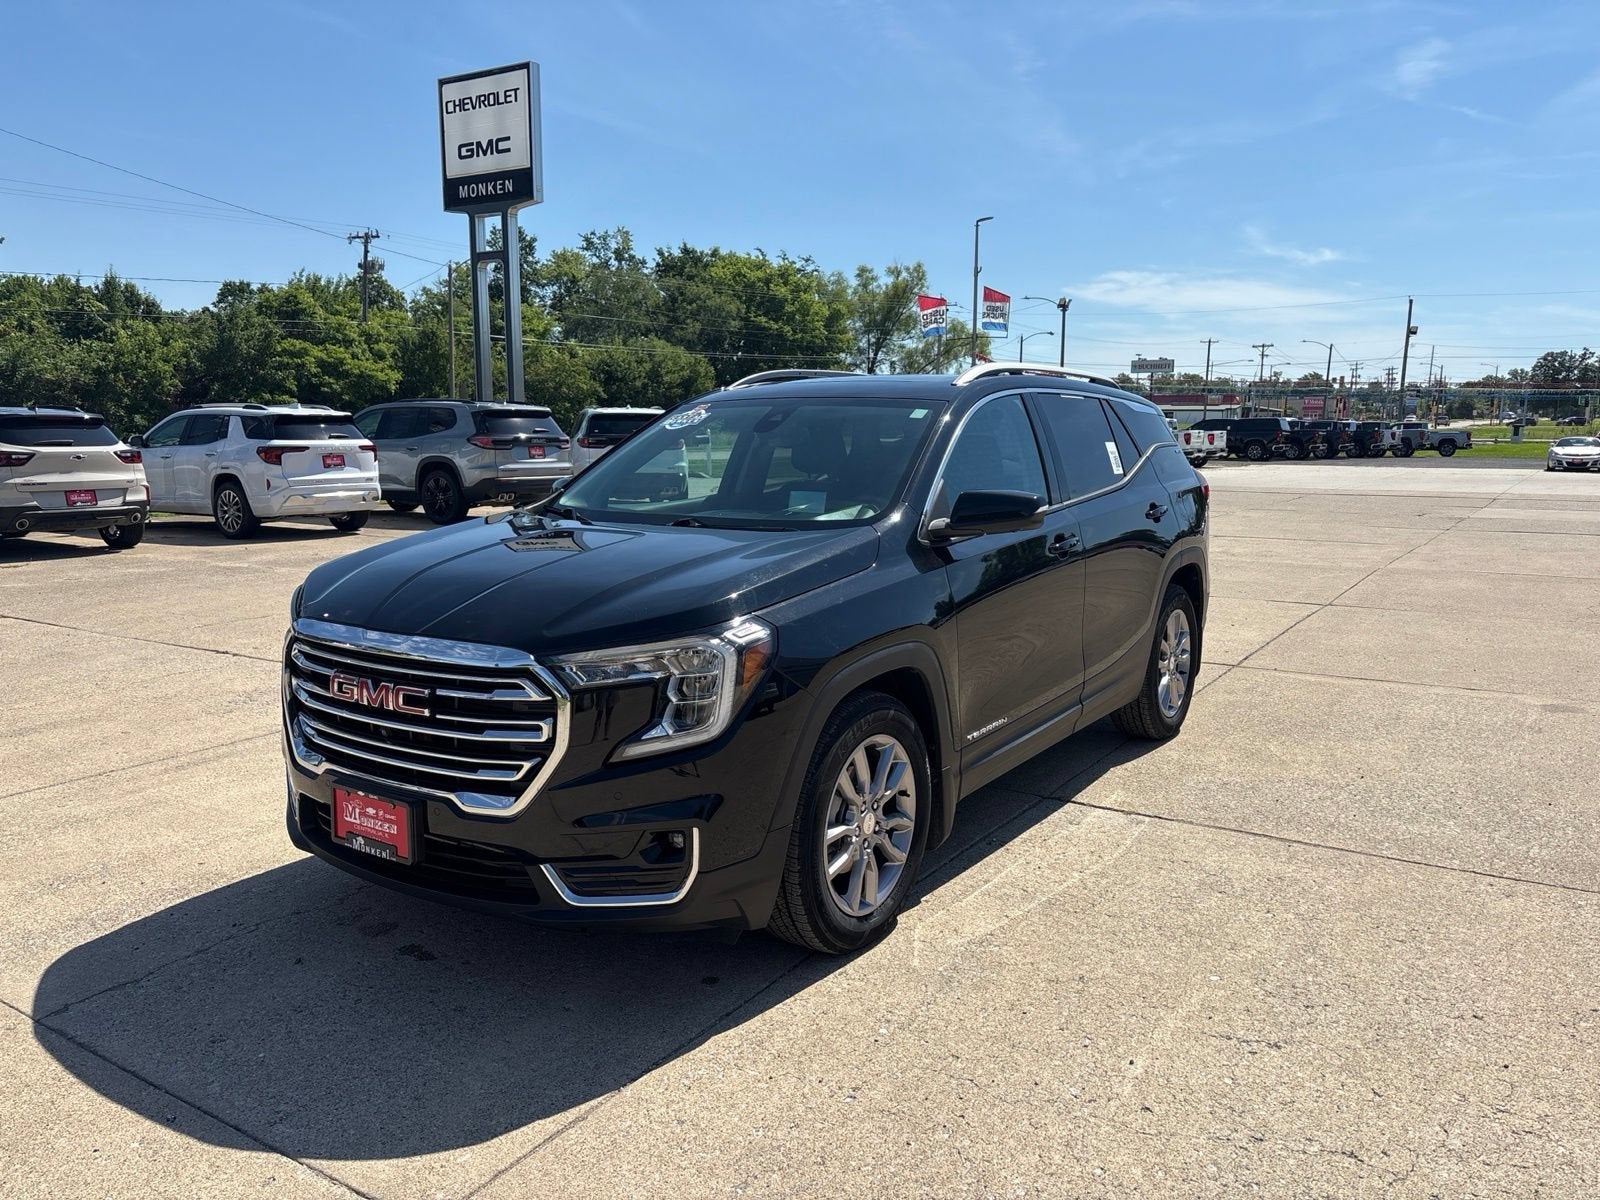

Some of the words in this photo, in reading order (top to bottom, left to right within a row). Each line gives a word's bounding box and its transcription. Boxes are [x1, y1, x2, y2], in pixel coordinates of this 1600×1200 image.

[445, 87, 520, 115] CHEVROLET
[457, 136, 511, 160] GMC
[459, 179, 513, 199] MONKEN
[330, 672, 430, 717] GMC
[967, 716, 1008, 741] TERRAIN
[343, 801, 397, 835] MONKEN
